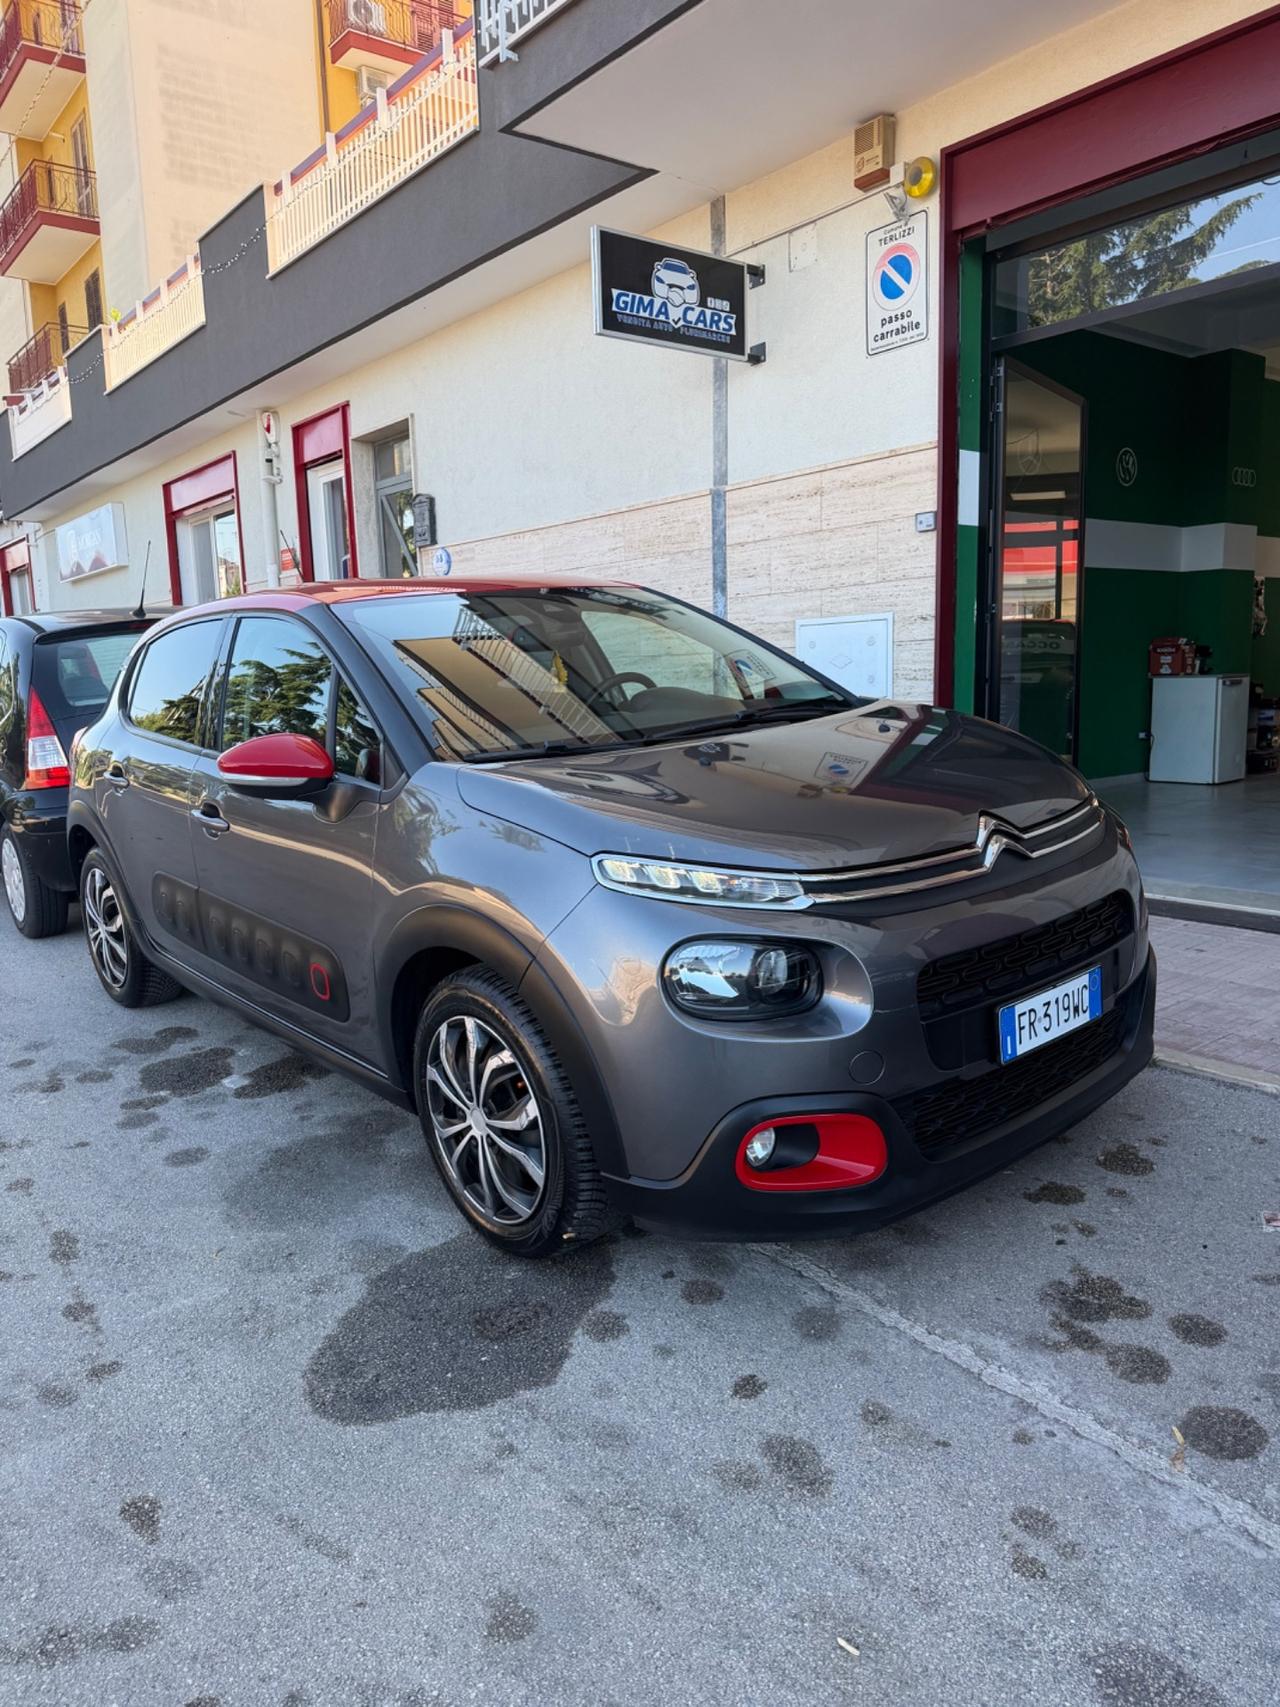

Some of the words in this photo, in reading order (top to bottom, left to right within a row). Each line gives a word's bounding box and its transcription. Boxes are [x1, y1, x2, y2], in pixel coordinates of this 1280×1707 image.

[878, 226, 915, 247] TERLIZZI
[614, 291, 670, 321] GIMA
[681, 305, 734, 333] CARS
[880, 309, 912, 328] passo
[873, 320, 921, 343] carrabile
